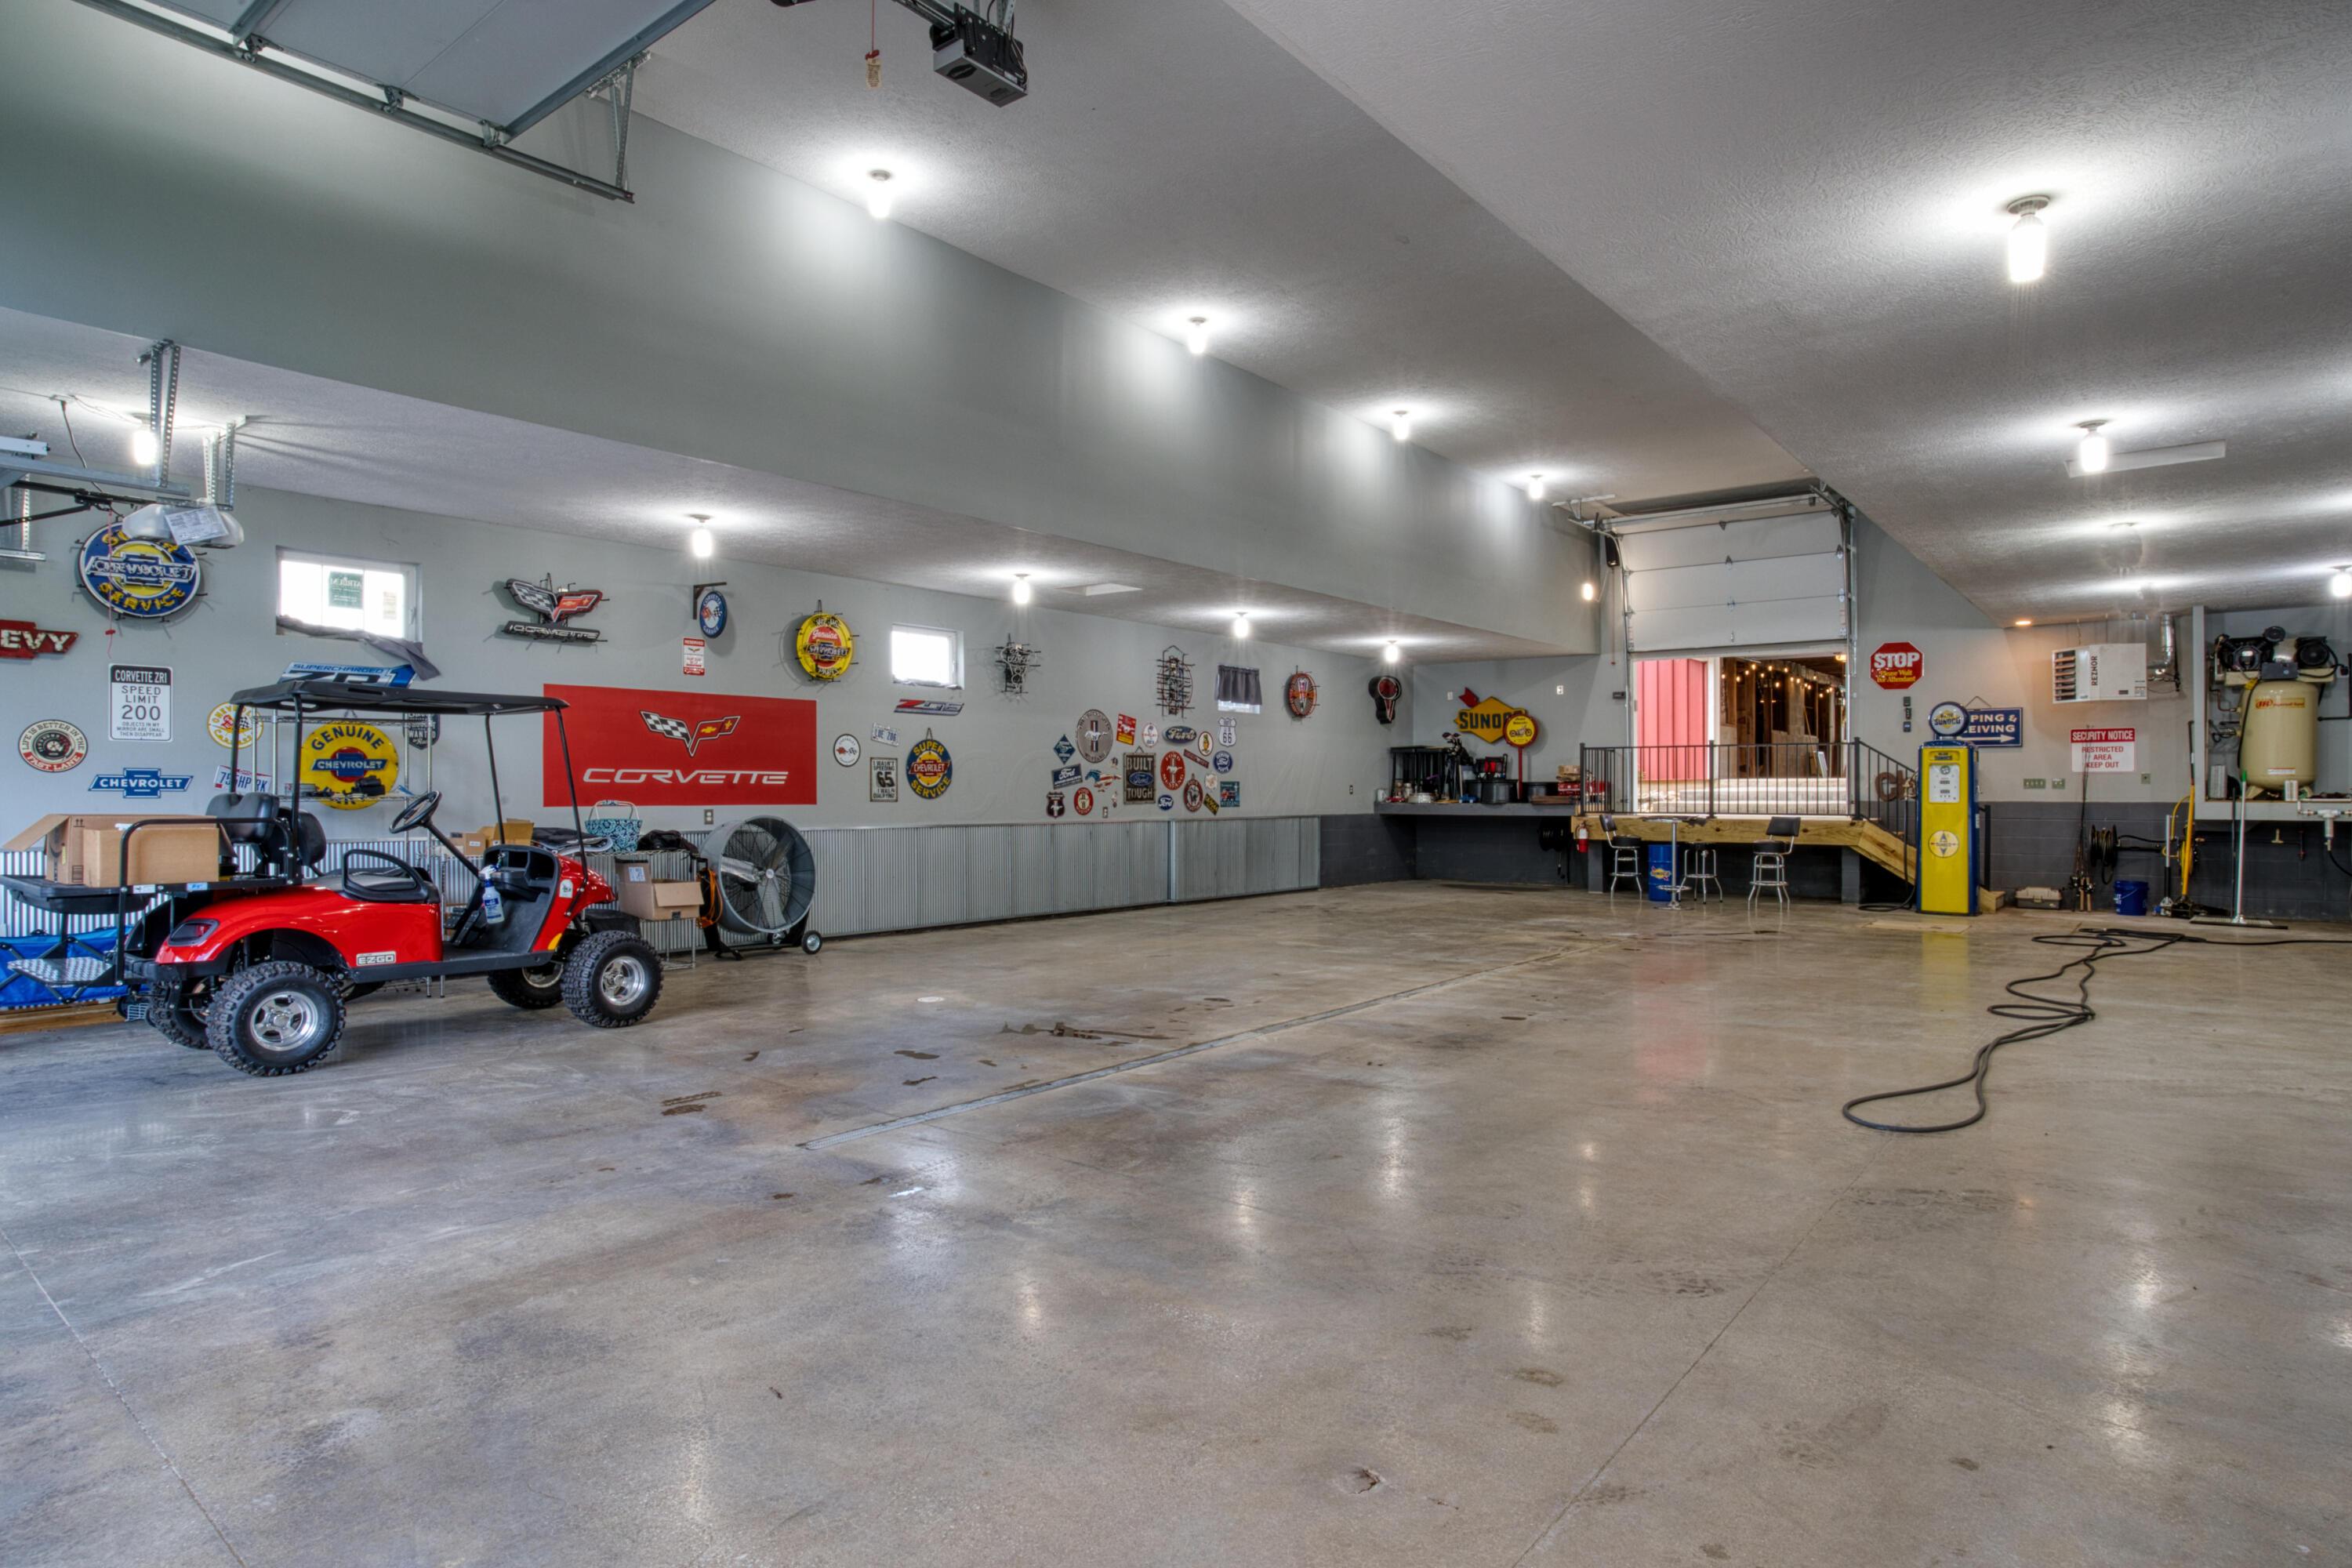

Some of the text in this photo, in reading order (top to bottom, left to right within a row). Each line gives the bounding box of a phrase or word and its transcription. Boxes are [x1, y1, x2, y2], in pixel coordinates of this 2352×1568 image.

[94, 561, 191, 578] CHEVROLET
[99, 583, 185, 611] SERVICE
[0, 629, 72, 652] EVY
[1874, 652, 1920, 668] STOP
[293, 663, 384, 673] SUPERCHARGED
[115, 670, 167, 684] CORVETTE ZR1
[122, 685, 162, 695] SPEED
[125, 695, 158, 704] LIMIT
[122, 705, 161, 720] 200
[1969, 713, 2017, 723] PING &
[37, 721, 70, 732] BETTER
[1458, 710, 1523, 730] SUNO
[1969, 724, 2016, 734] EIVING
[2072, 730, 2133, 741] SECURITY NOTICE
[311, 725, 384, 750] GENUINE
[1223, 732, 1232, 743] 66
[913, 741, 944, 756] SUPER
[27, 755, 80, 770] FAST LANE
[317, 760, 383, 769] CHEVROLET
[913, 764, 945, 772] CHEVROLET
[1127, 757, 1152, 770] BUILT
[583, 768, 789, 784] CORVETTE
[876, 771, 895, 788] 65
[1058, 768, 1076, 780] Ford
[100, 779, 183, 789] CHEVROLET
[911, 777, 951, 798] SERVICE
[1127, 788, 1152, 799] TOUGH
